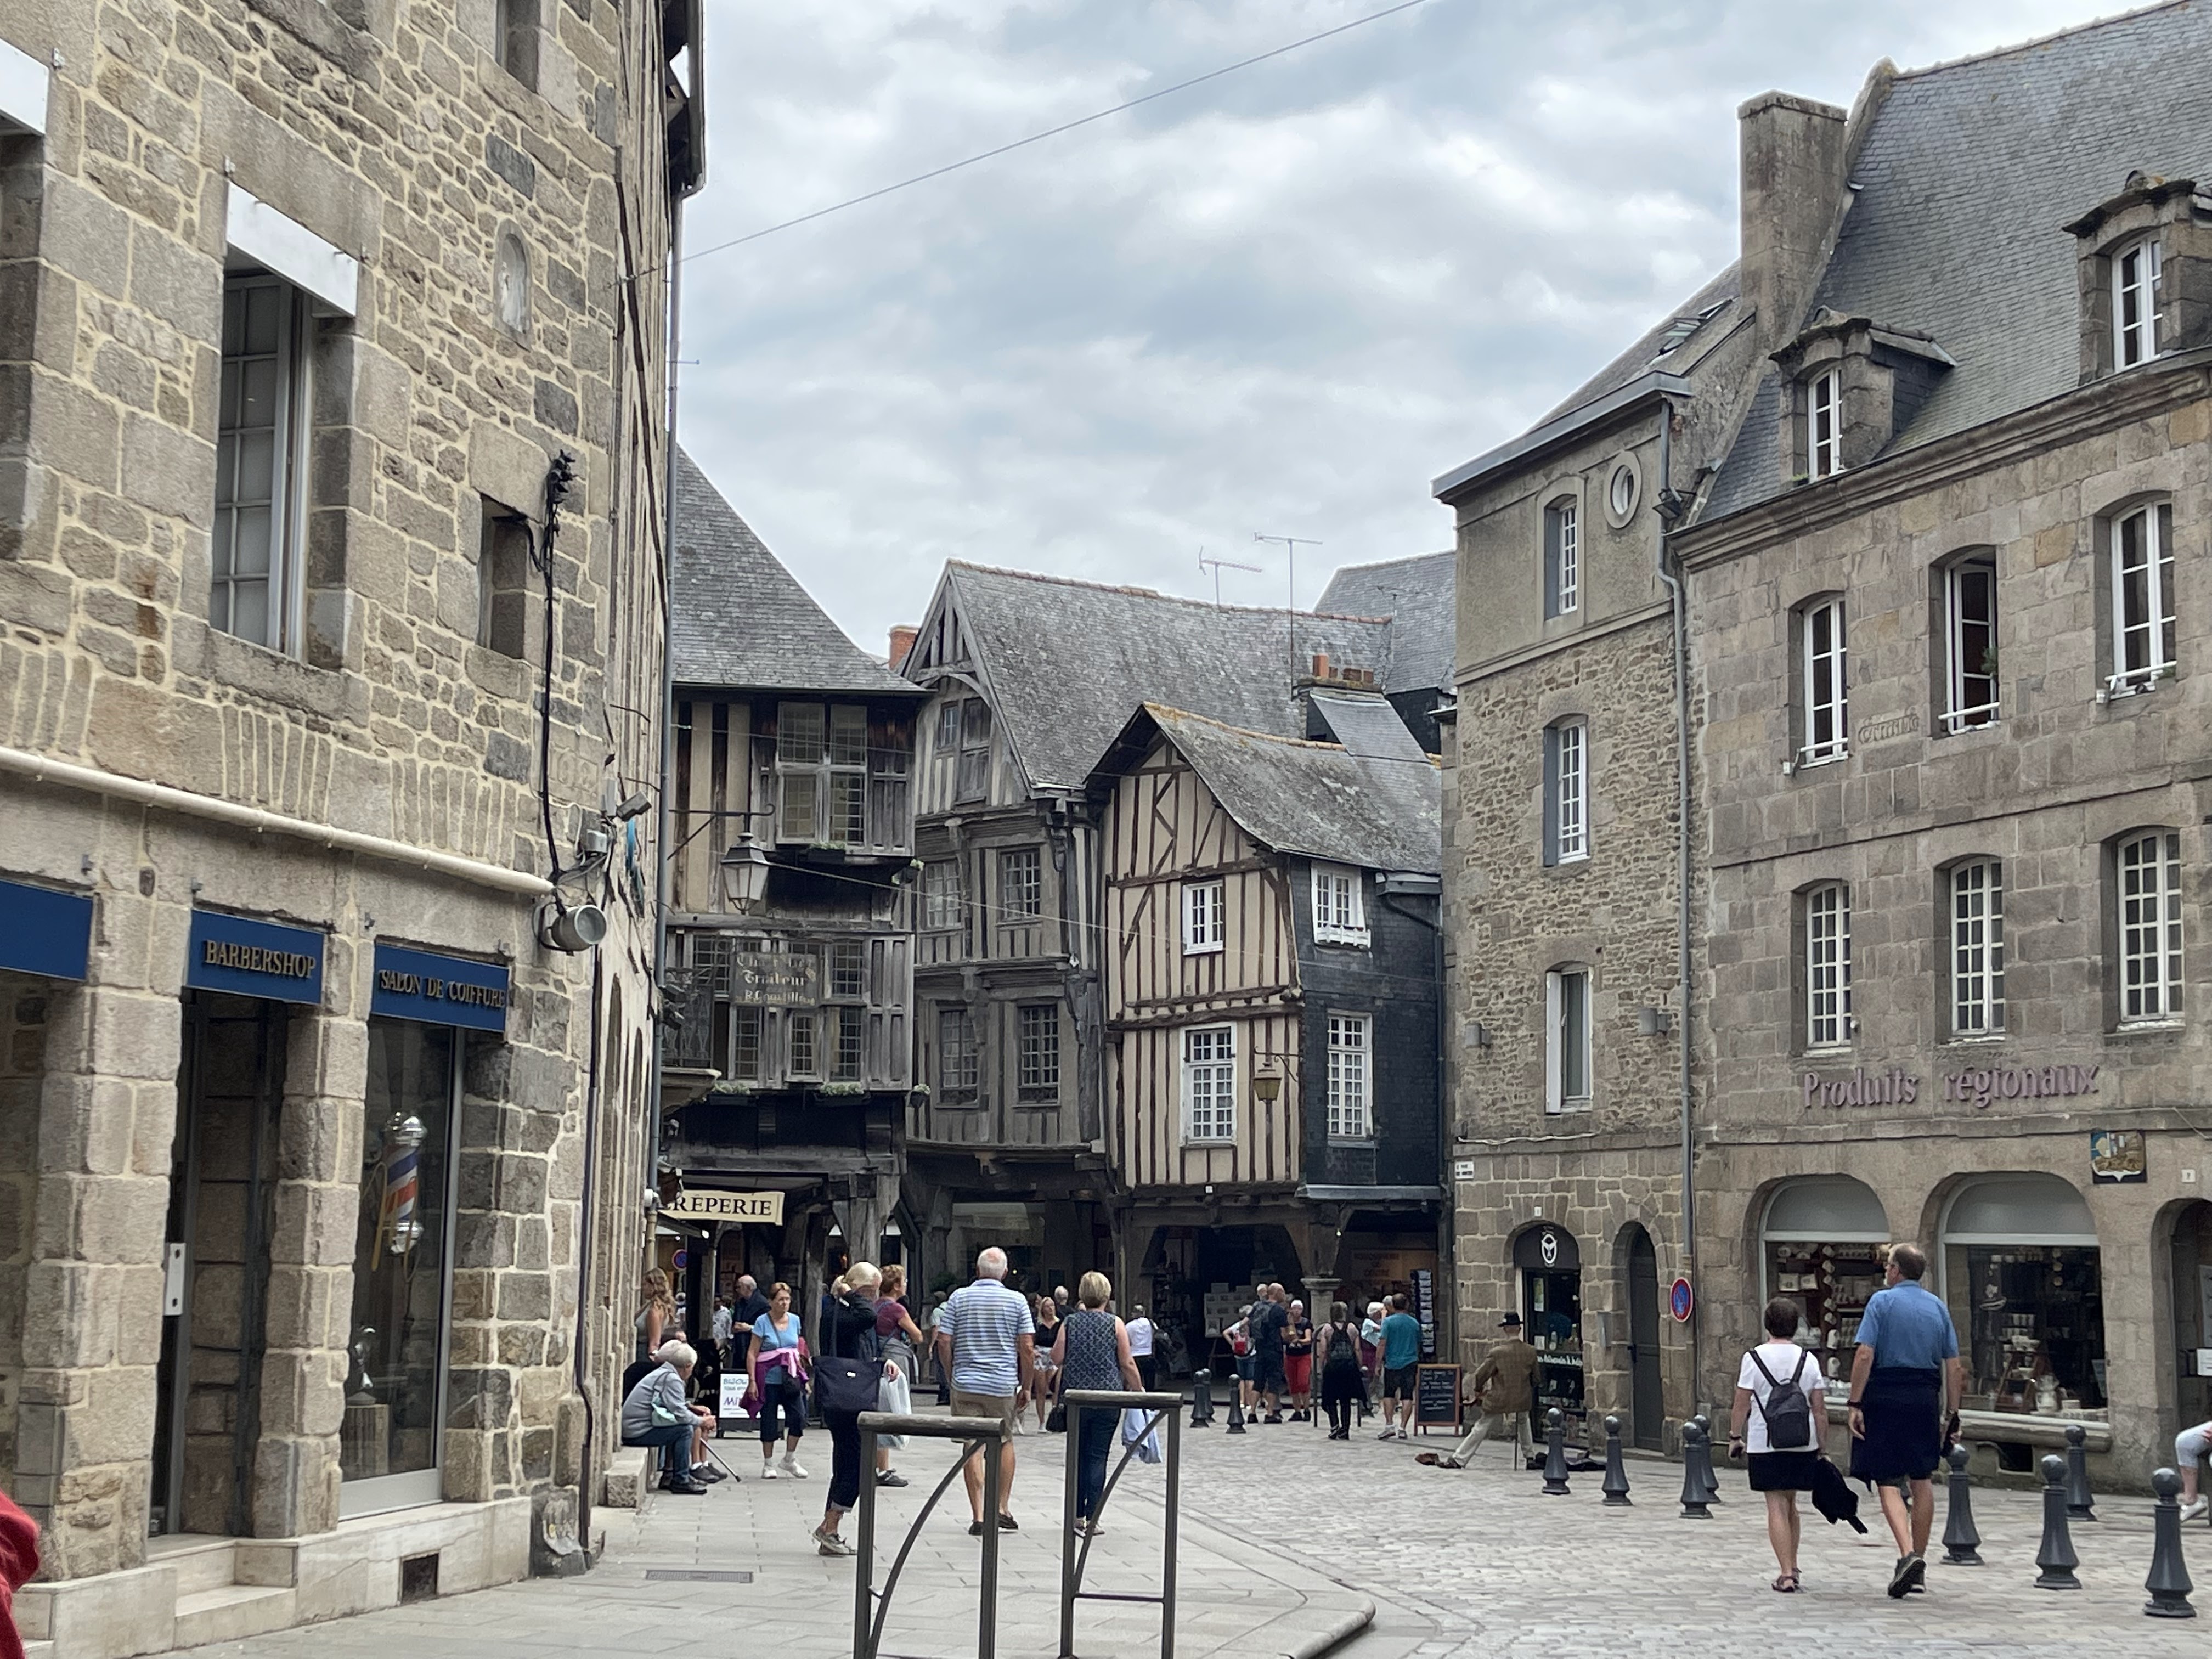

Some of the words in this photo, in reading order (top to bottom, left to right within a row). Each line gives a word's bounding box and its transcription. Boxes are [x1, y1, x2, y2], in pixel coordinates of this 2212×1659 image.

[205, 939, 317, 979] BARBERSHOP
[379, 969, 421, 995] SALON
[425, 977, 444, 999] DE
[447, 981, 506, 1008] COIFFURE
[1803, 1066, 1920, 1108] Produits
[1943, 1065, 2100, 1108] régionaux
